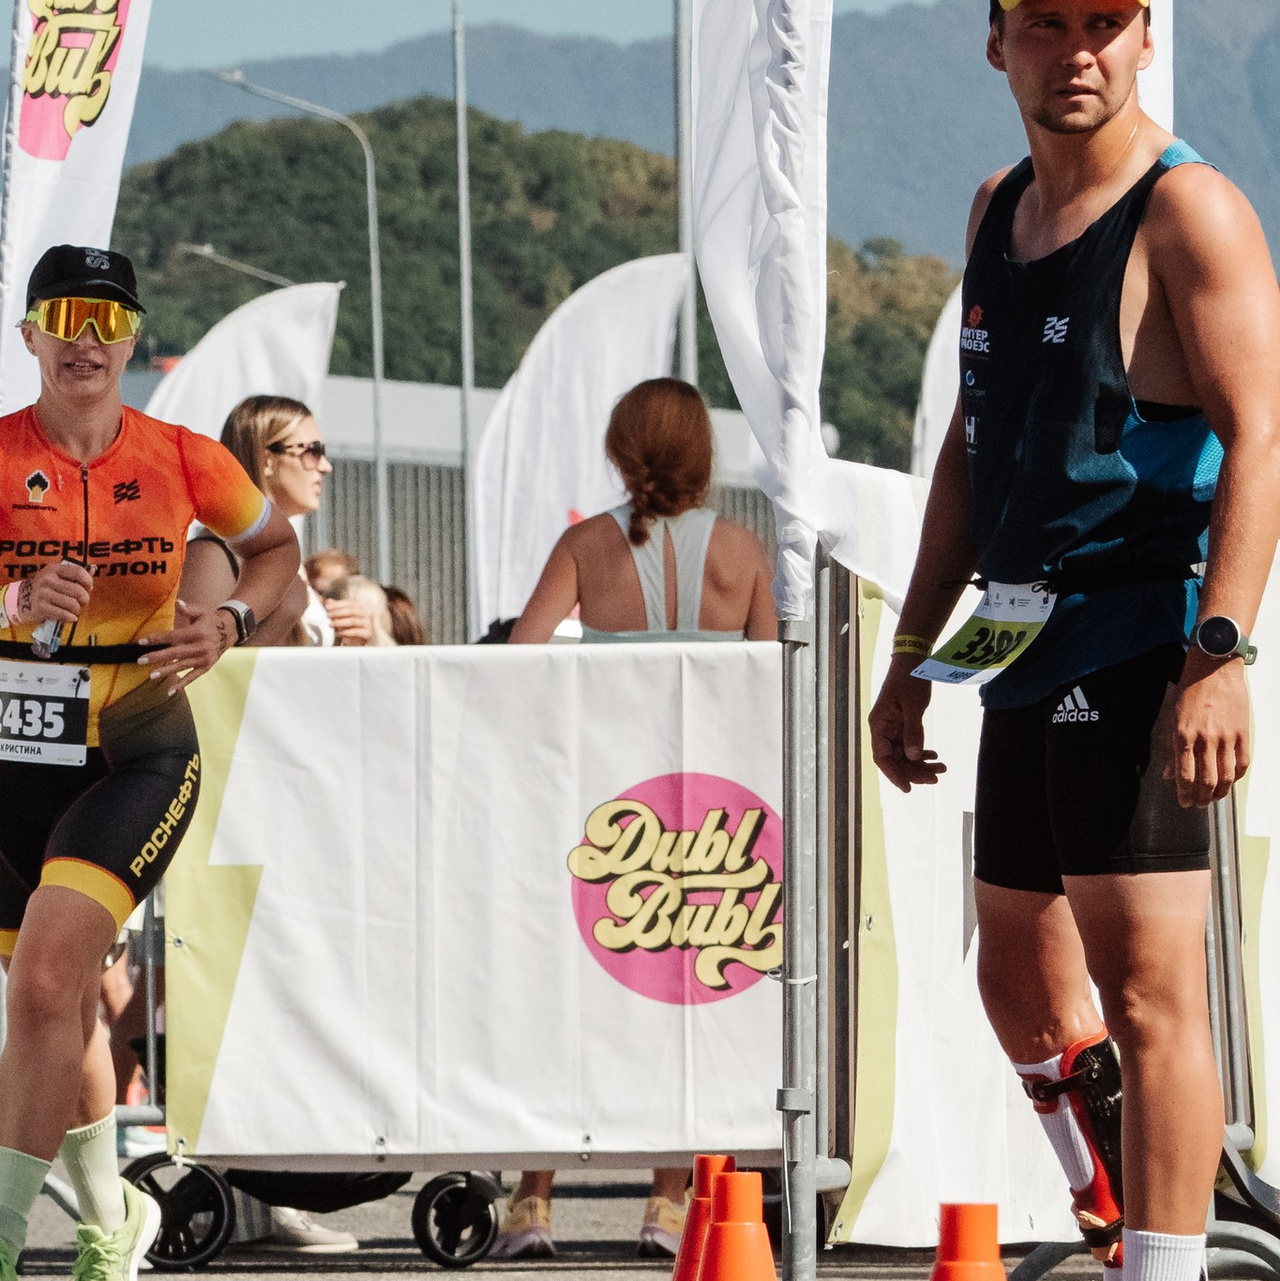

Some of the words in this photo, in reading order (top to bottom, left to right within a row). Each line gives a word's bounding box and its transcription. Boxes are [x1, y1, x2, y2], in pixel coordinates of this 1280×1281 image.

[3, 560, 167, 577] ТРТЛОН
[1052, 707, 1100, 724] adidas
[0, 743, 42, 756] КРИСТИНА
[129, 753, 200, 878] РОСНЕФТЬ
[567, 798, 769, 884] Dubl
[592, 870, 784, 991] Bubl
